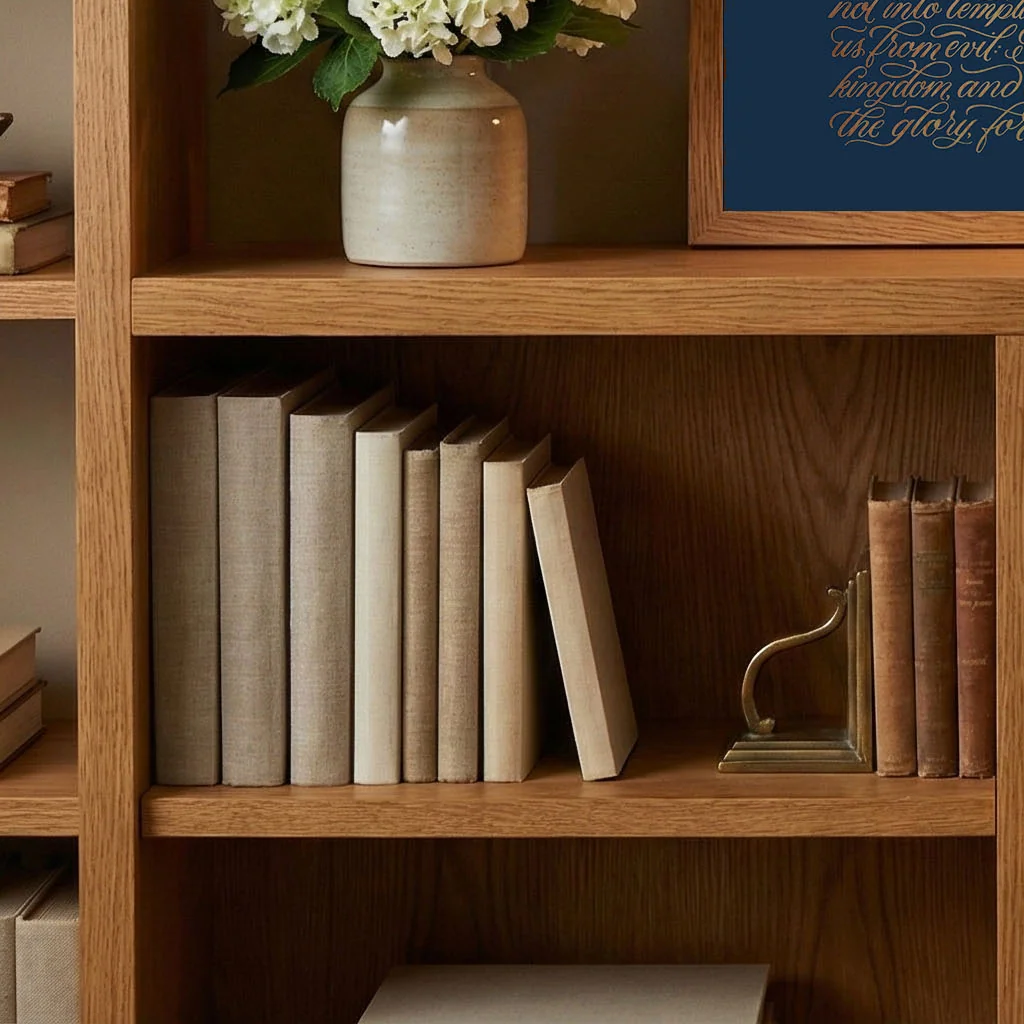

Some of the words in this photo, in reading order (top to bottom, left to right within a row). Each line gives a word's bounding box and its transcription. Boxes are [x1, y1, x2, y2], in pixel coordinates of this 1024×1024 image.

[831, 26, 867, 58] us
[866, 20, 941, 68] from
[828, 61, 952, 108] kingdom,
[957, 64, 1022, 98] and
[829, 107, 885, 138] the
[845, 101, 977, 148] glory,
